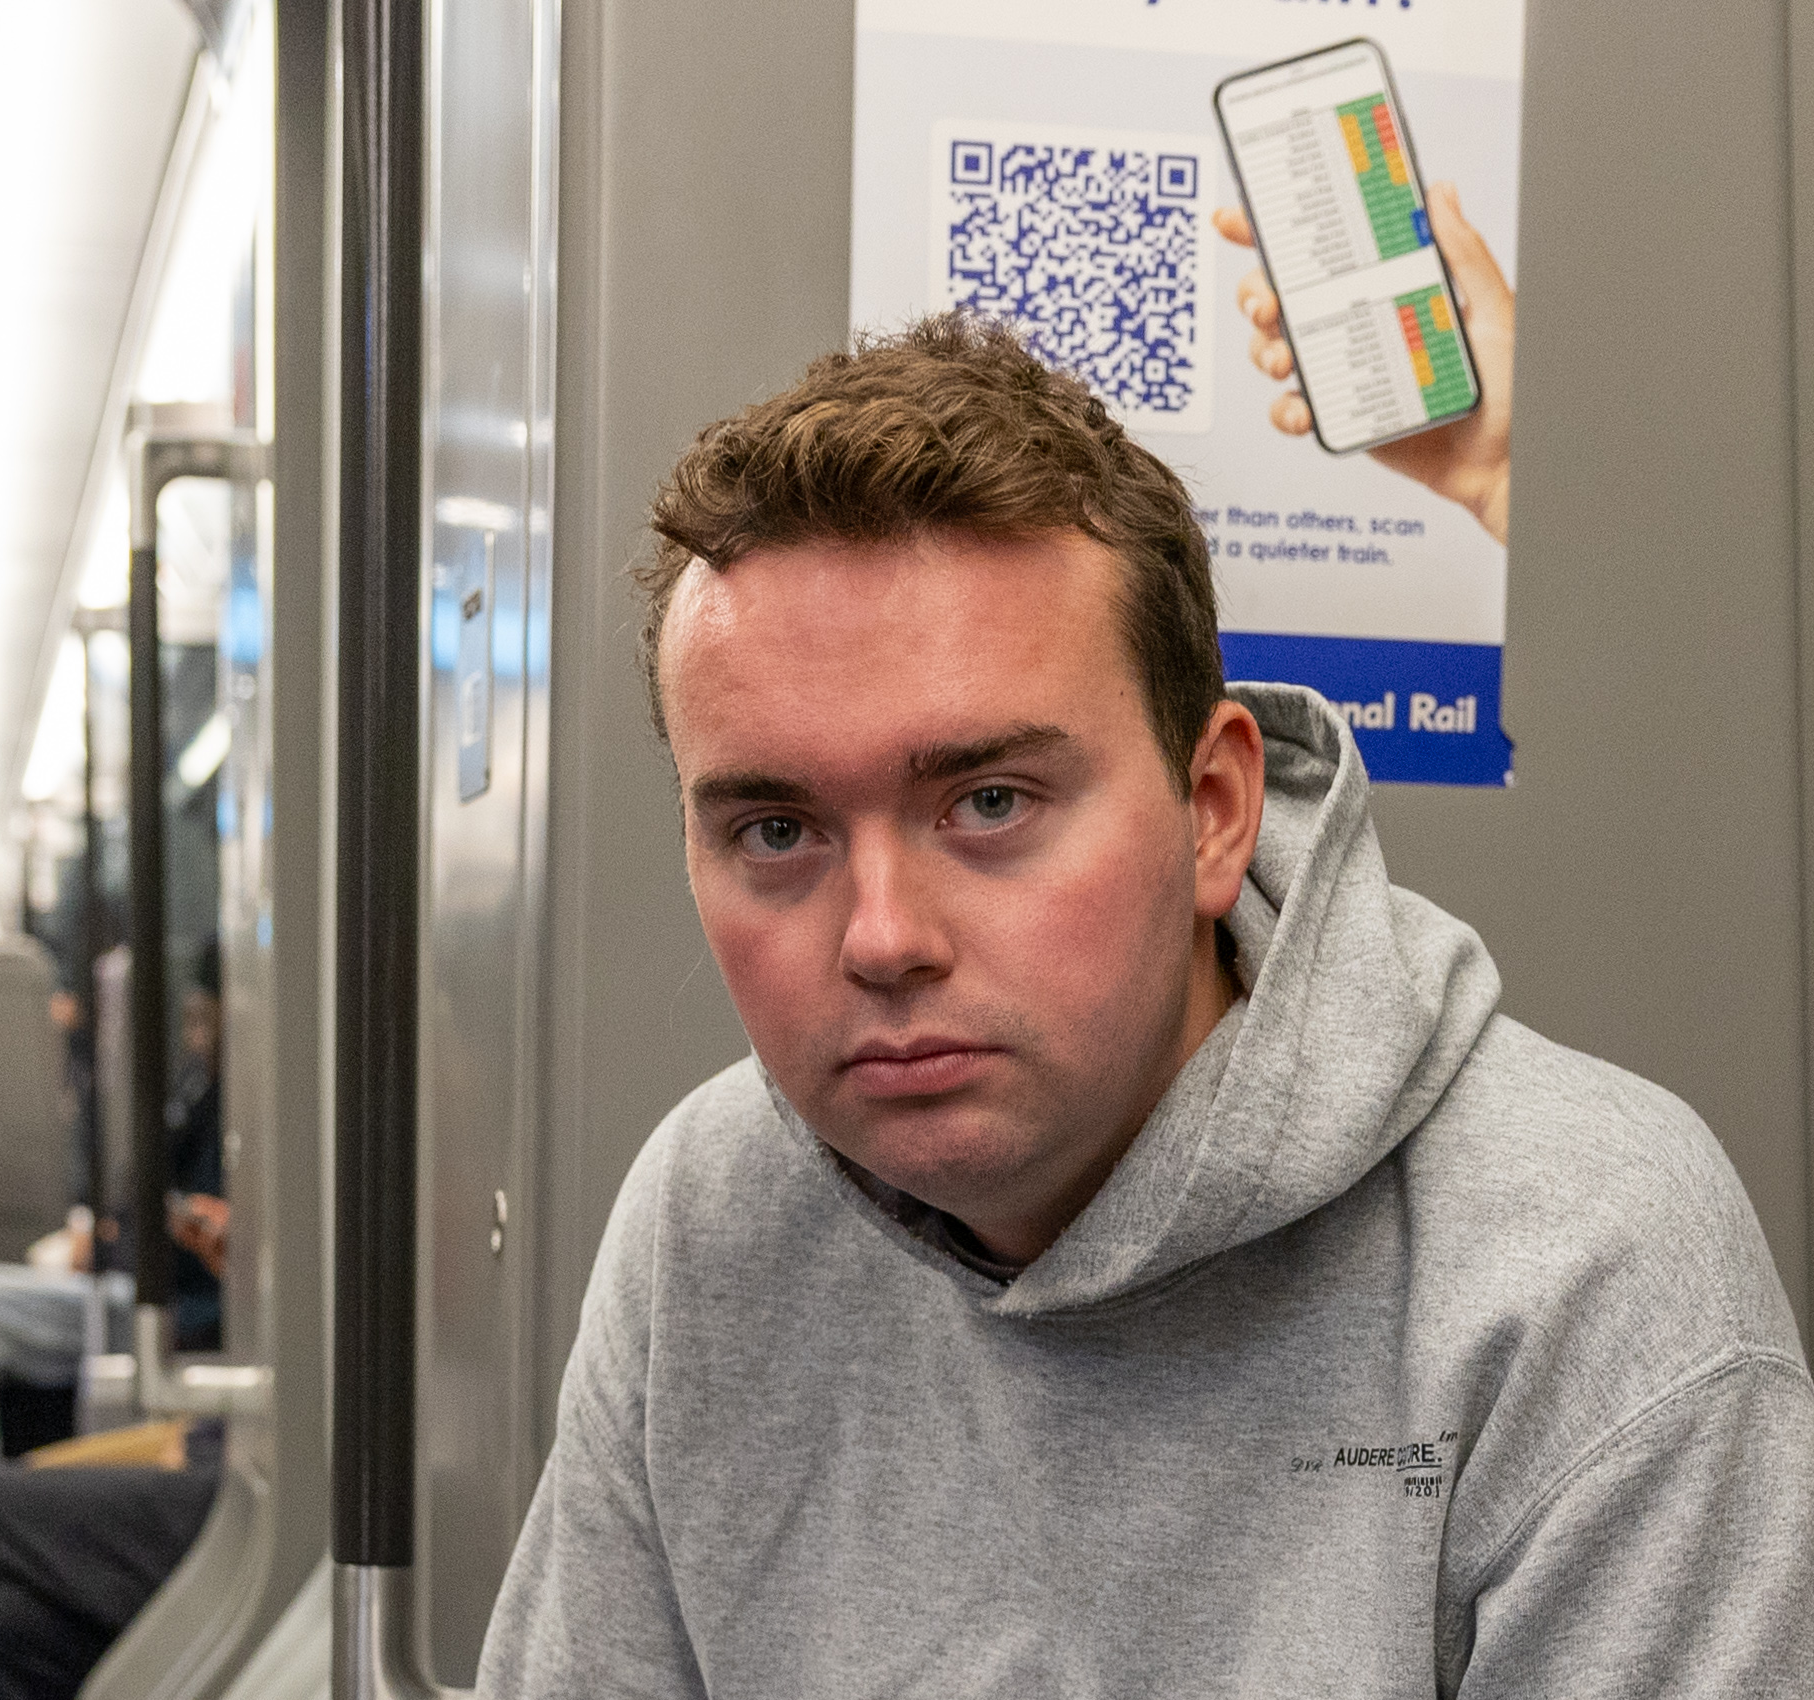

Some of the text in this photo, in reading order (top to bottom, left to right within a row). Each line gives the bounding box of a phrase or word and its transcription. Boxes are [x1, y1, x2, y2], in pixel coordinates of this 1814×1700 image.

[1227, 507, 1279, 527] than
[1286, 510, 1359, 534] others,
[1369, 517, 1424, 537] scan
[1226, 540, 1242, 558] a
[1248, 539, 1330, 562] quieter
[1337, 543, 1392, 565] train.
[1408, 692, 1477, 735] Rail
[1333, 1447, 1395, 1467] AUDERE
